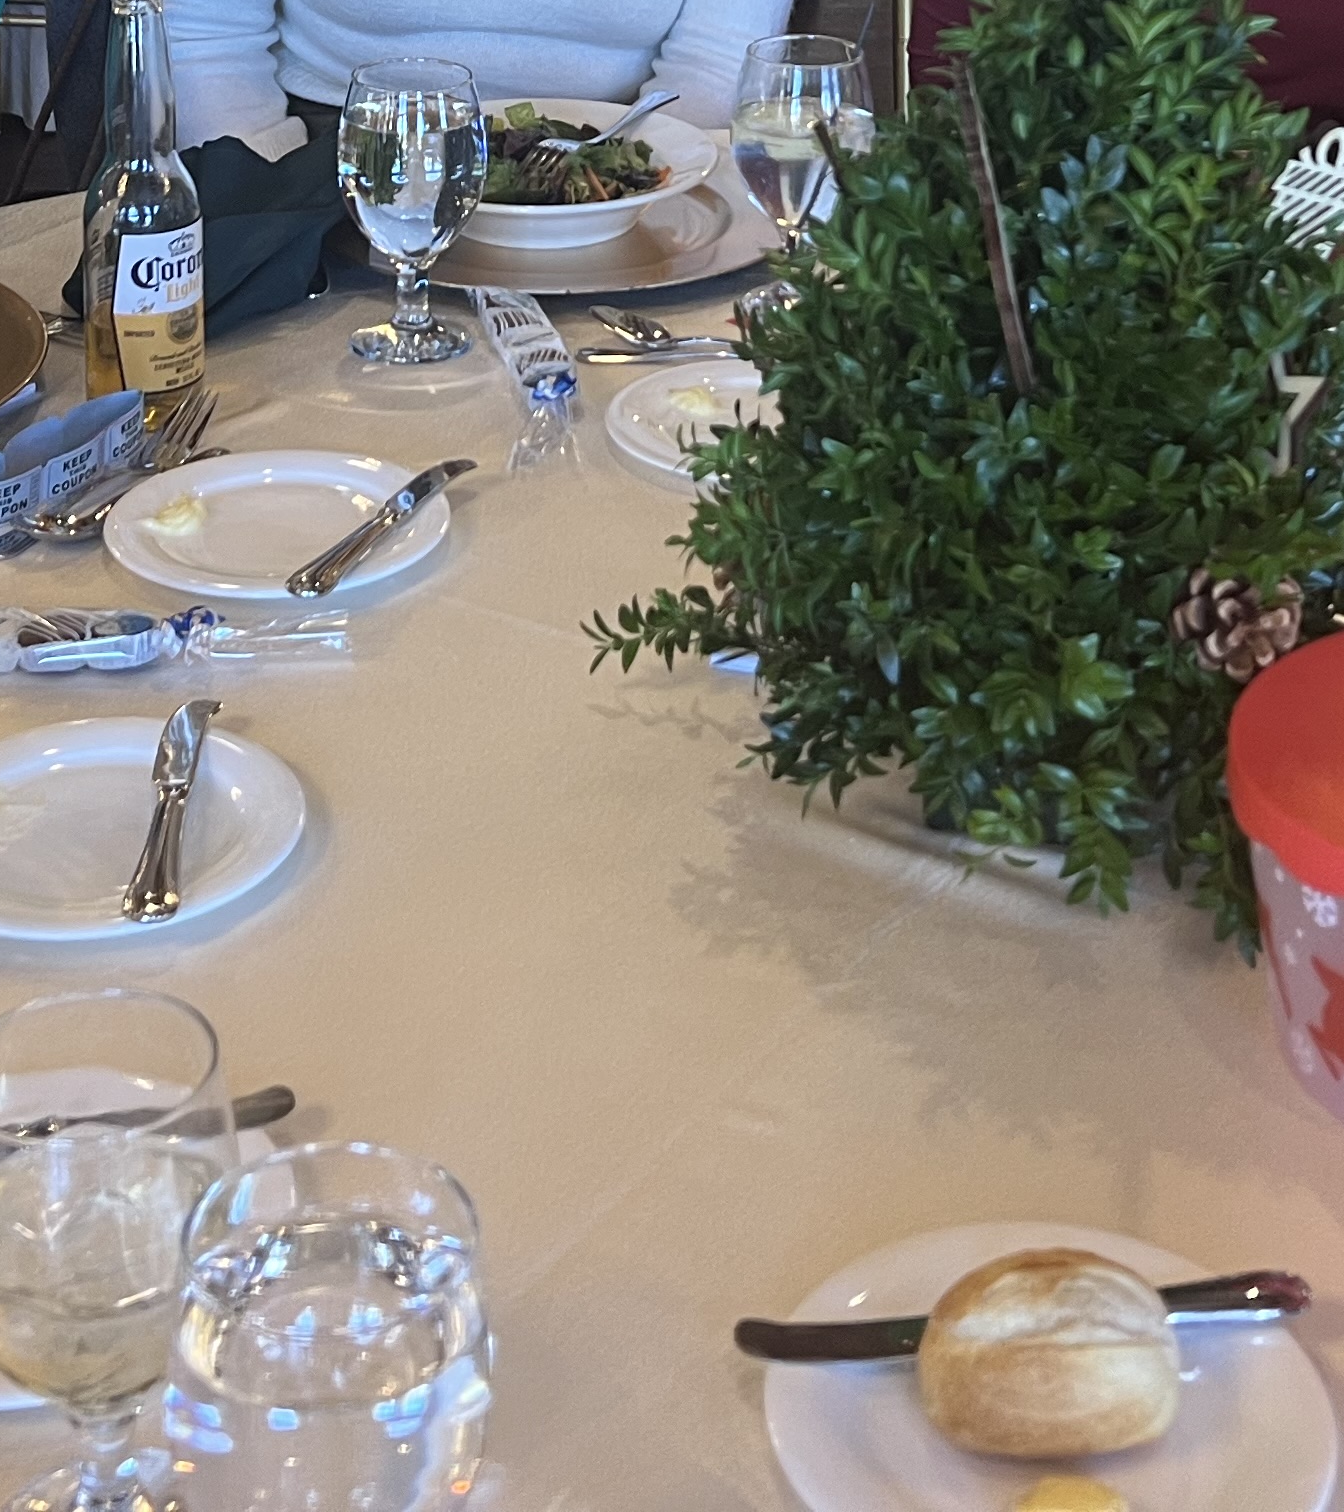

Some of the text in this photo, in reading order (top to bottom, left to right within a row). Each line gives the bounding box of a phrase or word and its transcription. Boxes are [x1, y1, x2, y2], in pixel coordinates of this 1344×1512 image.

[130, 248, 203, 292] Coron
[62, 448, 93, 473] KEEP
[51, 463, 98, 495] COUPON
